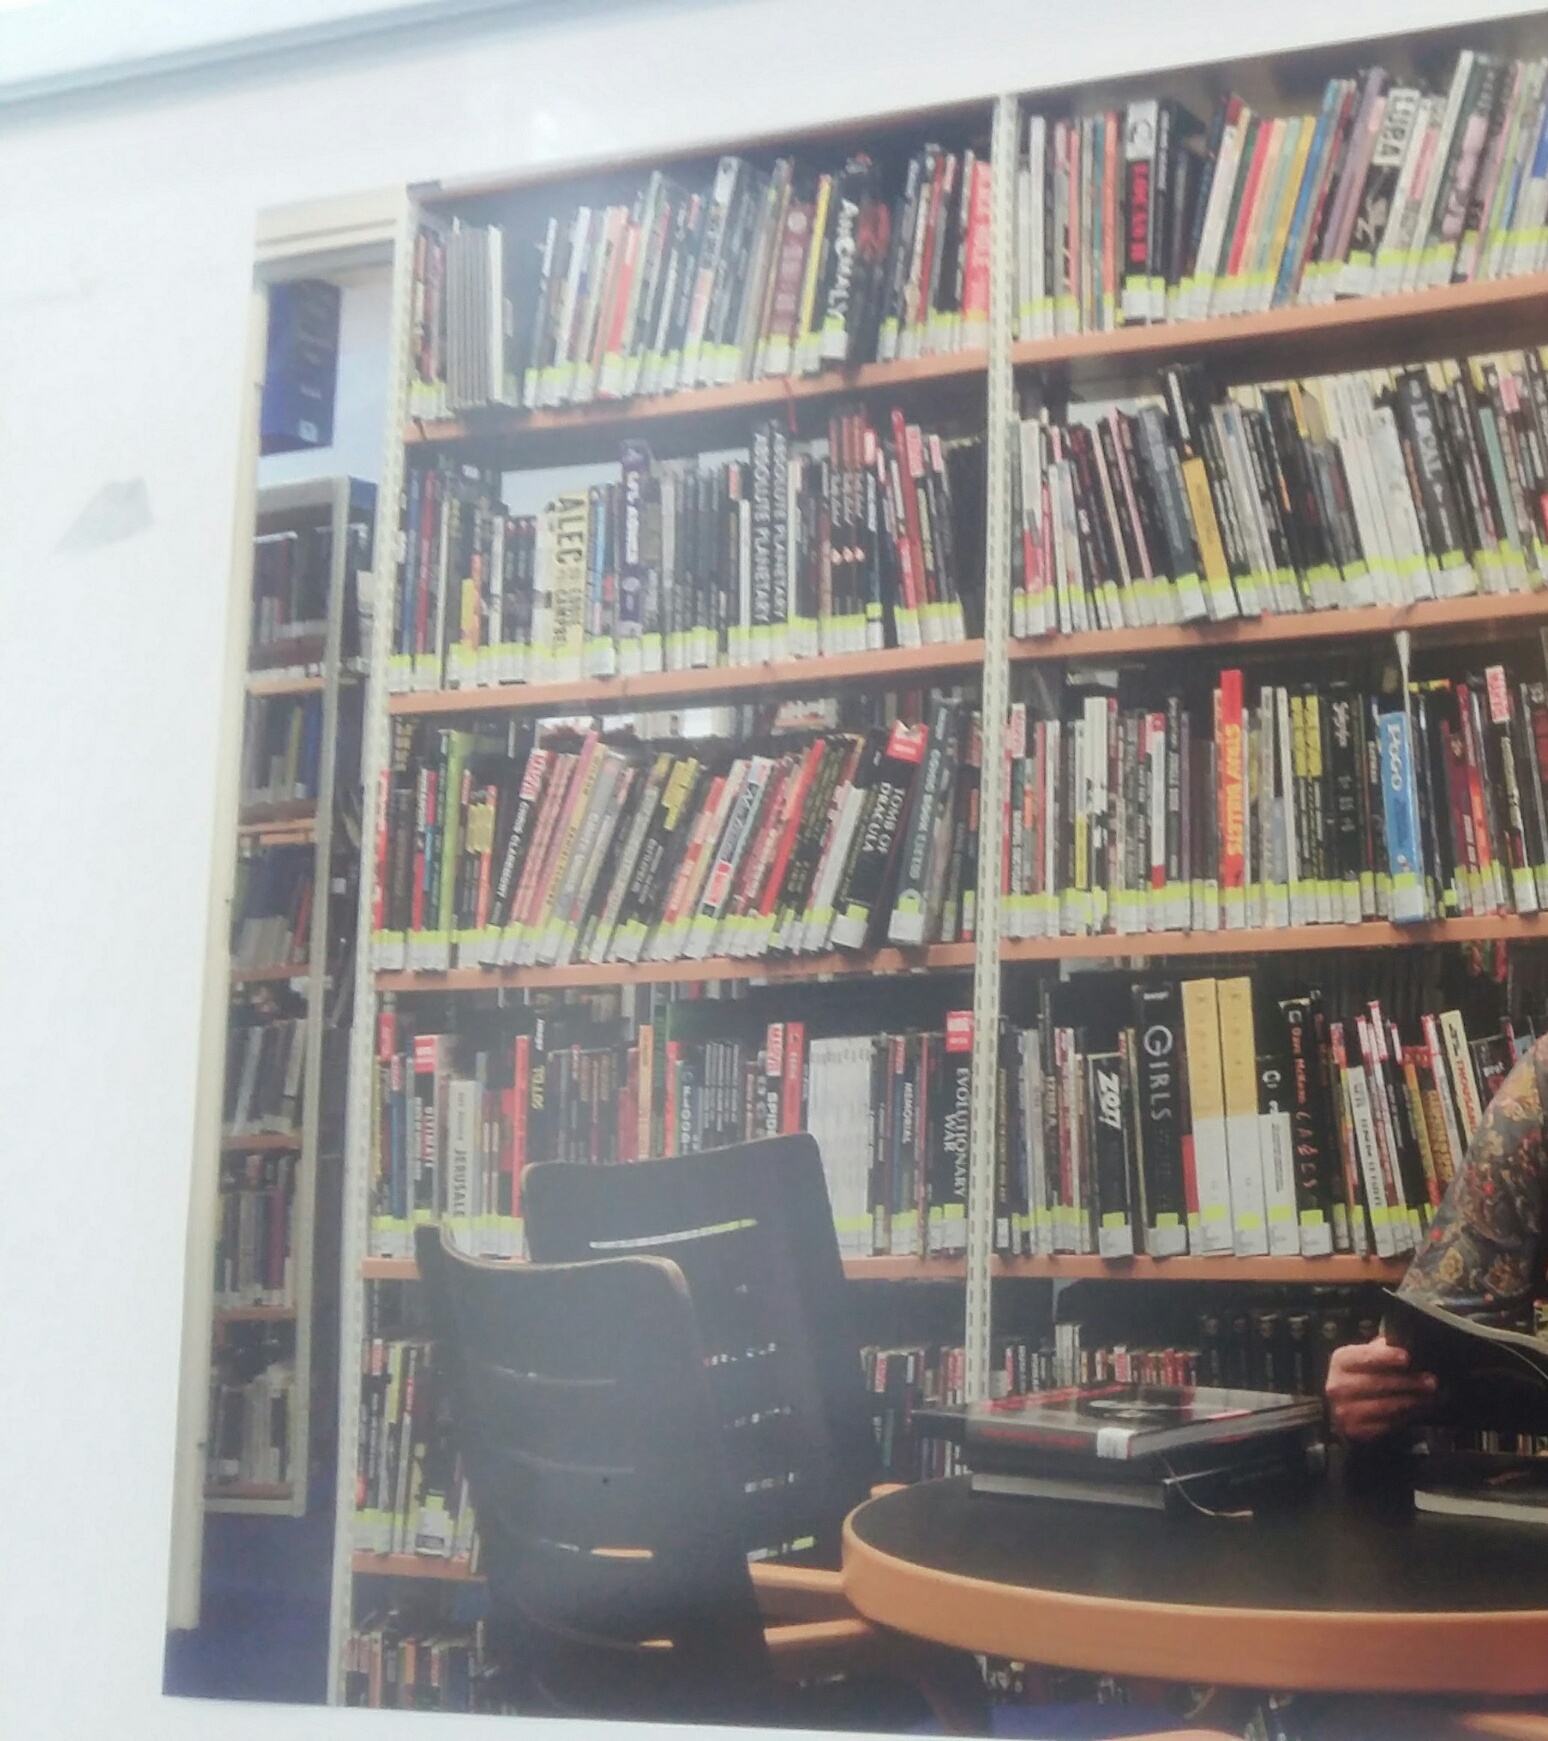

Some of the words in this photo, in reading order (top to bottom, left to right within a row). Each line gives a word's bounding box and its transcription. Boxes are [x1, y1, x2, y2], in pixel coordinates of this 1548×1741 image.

[1409, 400, 1444, 480] LOCAL
[555, 497, 584, 565] ALEC
[862, 782, 892, 853] DRACULA
[882, 787, 905, 832] TOMB
[877, 833, 892, 855] OF
[1291, 1027, 1303, 1055] Dave
[1097, 1070, 1122, 1130] ZOT!
[1142, 1024, 1172, 1122] GIRLS
[902, 1082, 913, 1144] MEMORIAL
[942, 1113, 957, 1153] WAR
[952, 1067, 970, 1197] EVOLUTIONARY
